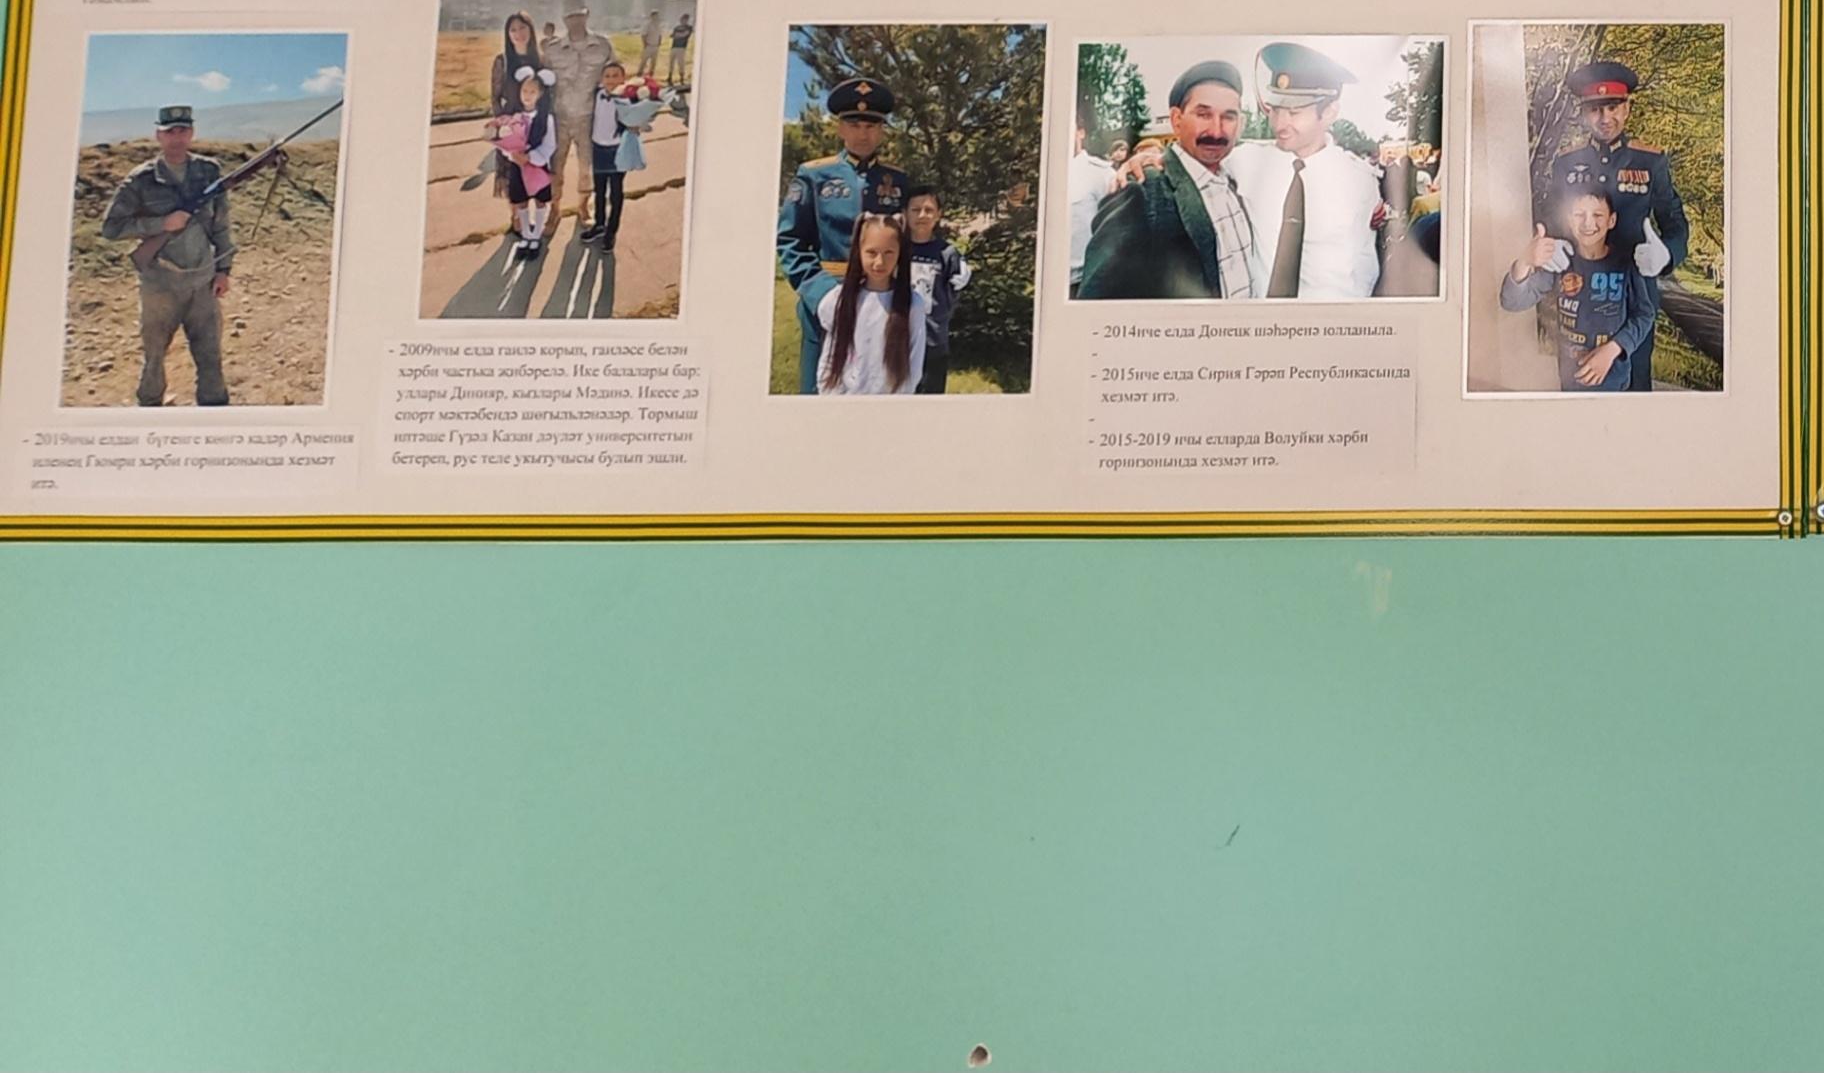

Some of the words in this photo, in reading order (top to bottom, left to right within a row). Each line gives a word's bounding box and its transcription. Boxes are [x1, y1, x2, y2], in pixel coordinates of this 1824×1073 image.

[1590, 272, 1625, 302] 95
[1103, 325, 1162, 338] 2014нче
[1164, 328, 1196, 339] елда
[1197, 324, 1251, 340] Донецк
[1101, 366, 1160, 381] 2015нче
[1162, 370, 1195, 381] елда
[1197, 366, 1242, 383] Сирия
[1245, 366, 1286, 383] Гәрәп
[1289, 364, 1411, 382] Республикасында
[1101, 392, 1149, 403] хезмәт
[1151, 392, 1179, 403] итә.
[1099, 432, 1172, 447] 2015-2019
[1174, 436, 1203, 446] нчы
[1205, 434, 1261, 448] елларда
[1328, 430, 1369, 448] хәрби
[1201, 456, 1249, 467] хезмәт
[1252, 456, 1279, 466] итә.
